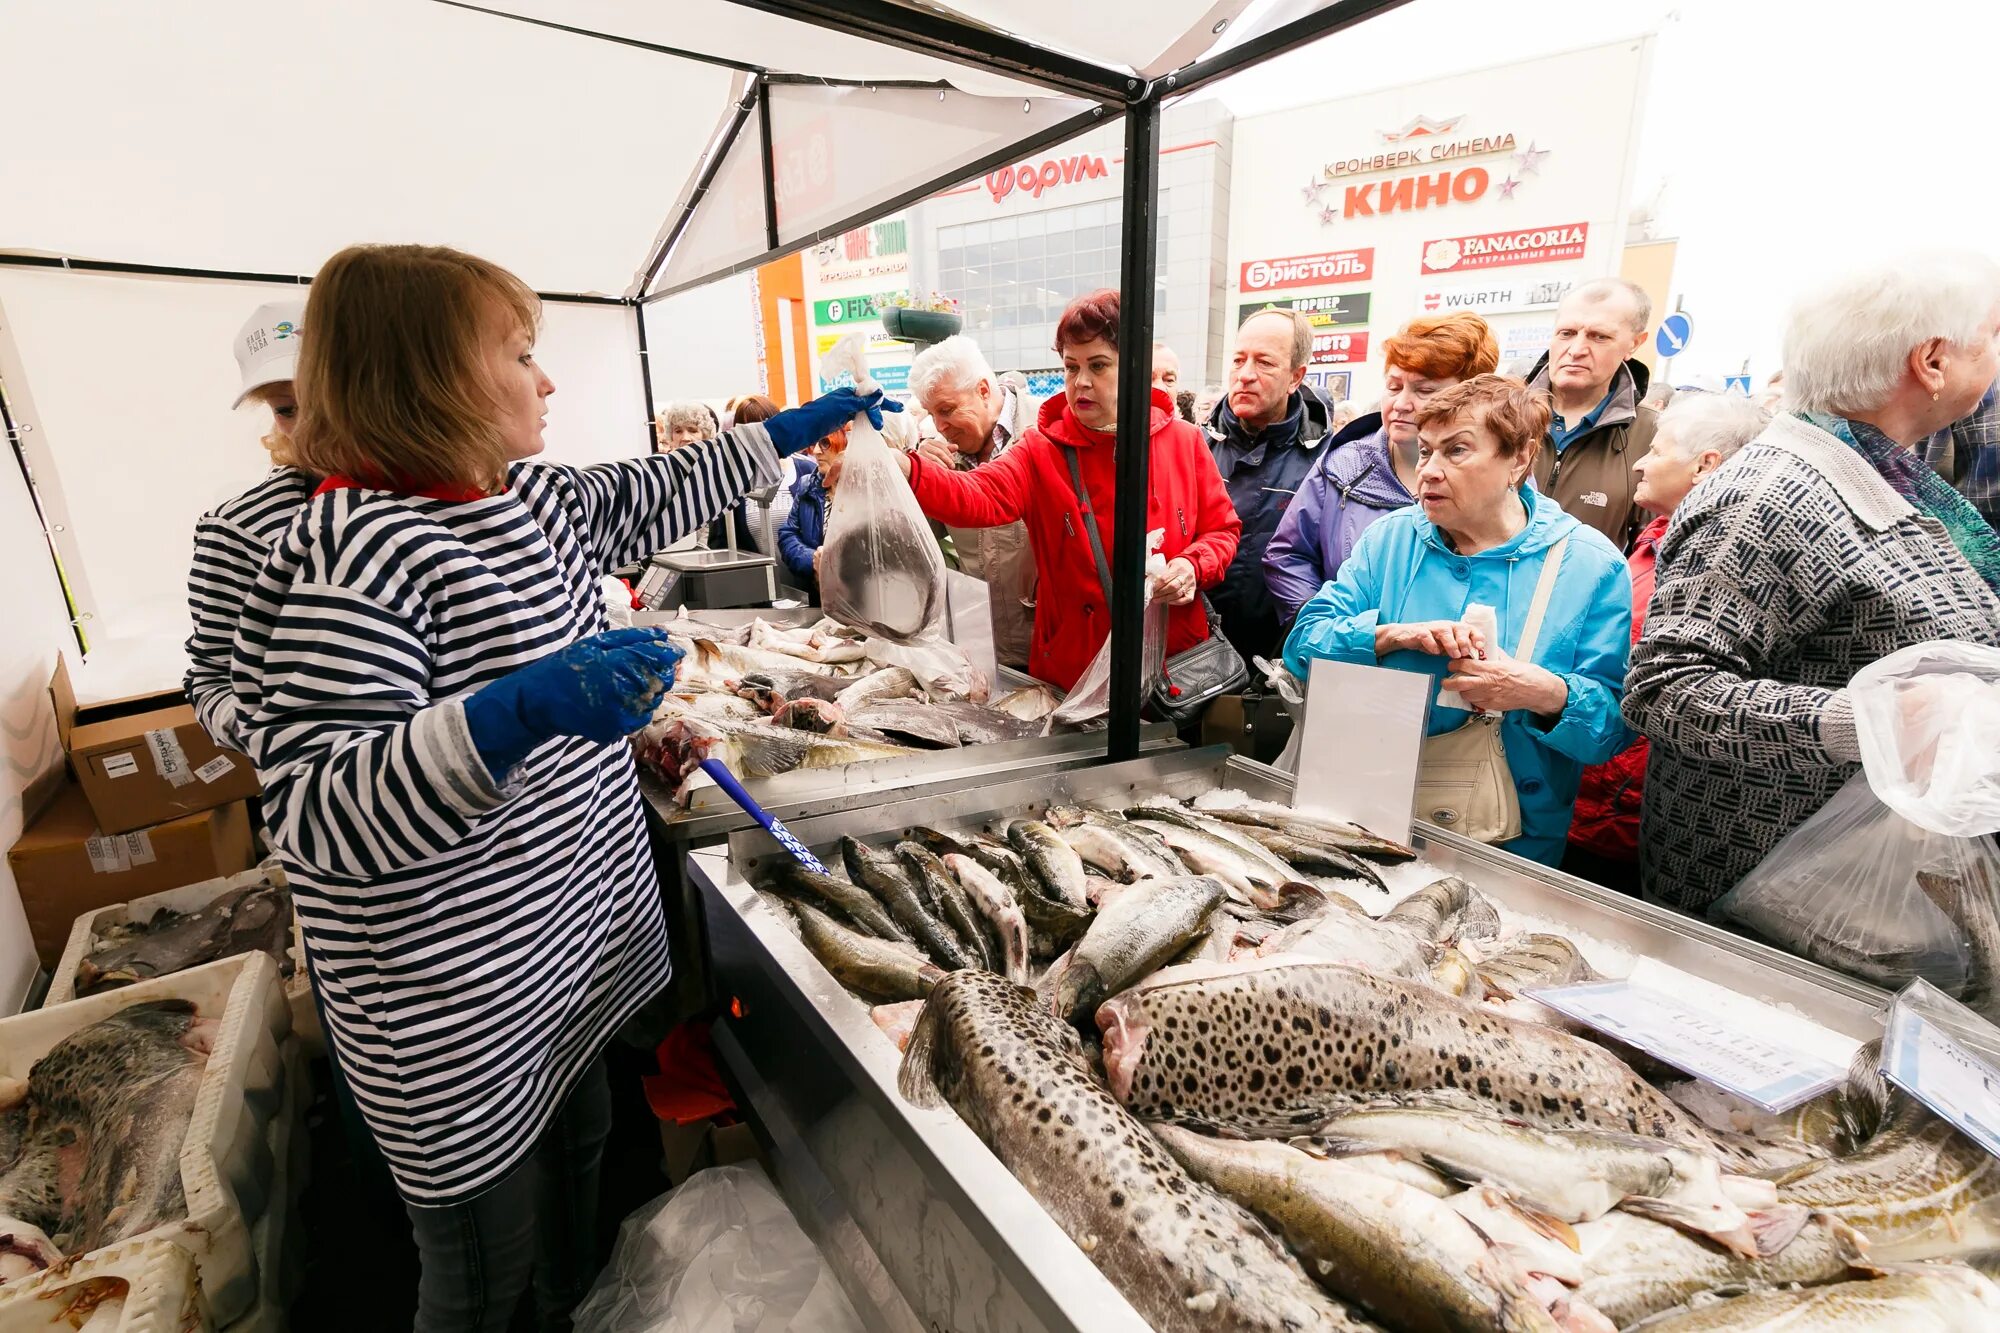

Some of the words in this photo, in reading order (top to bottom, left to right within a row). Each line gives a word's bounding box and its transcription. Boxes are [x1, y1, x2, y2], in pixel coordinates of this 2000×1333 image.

[1324, 148, 1422, 177] КРОНВЕРК
[1430, 133, 1517, 160] СИНЕМА
[1344, 167, 1490, 219] КИНО
[1463, 226, 1585, 256] FANAGORIA
[1246, 258, 1366, 288] Бристоль
[1462, 251, 1545, 266] НАТУРАЛЬНЫЕ
